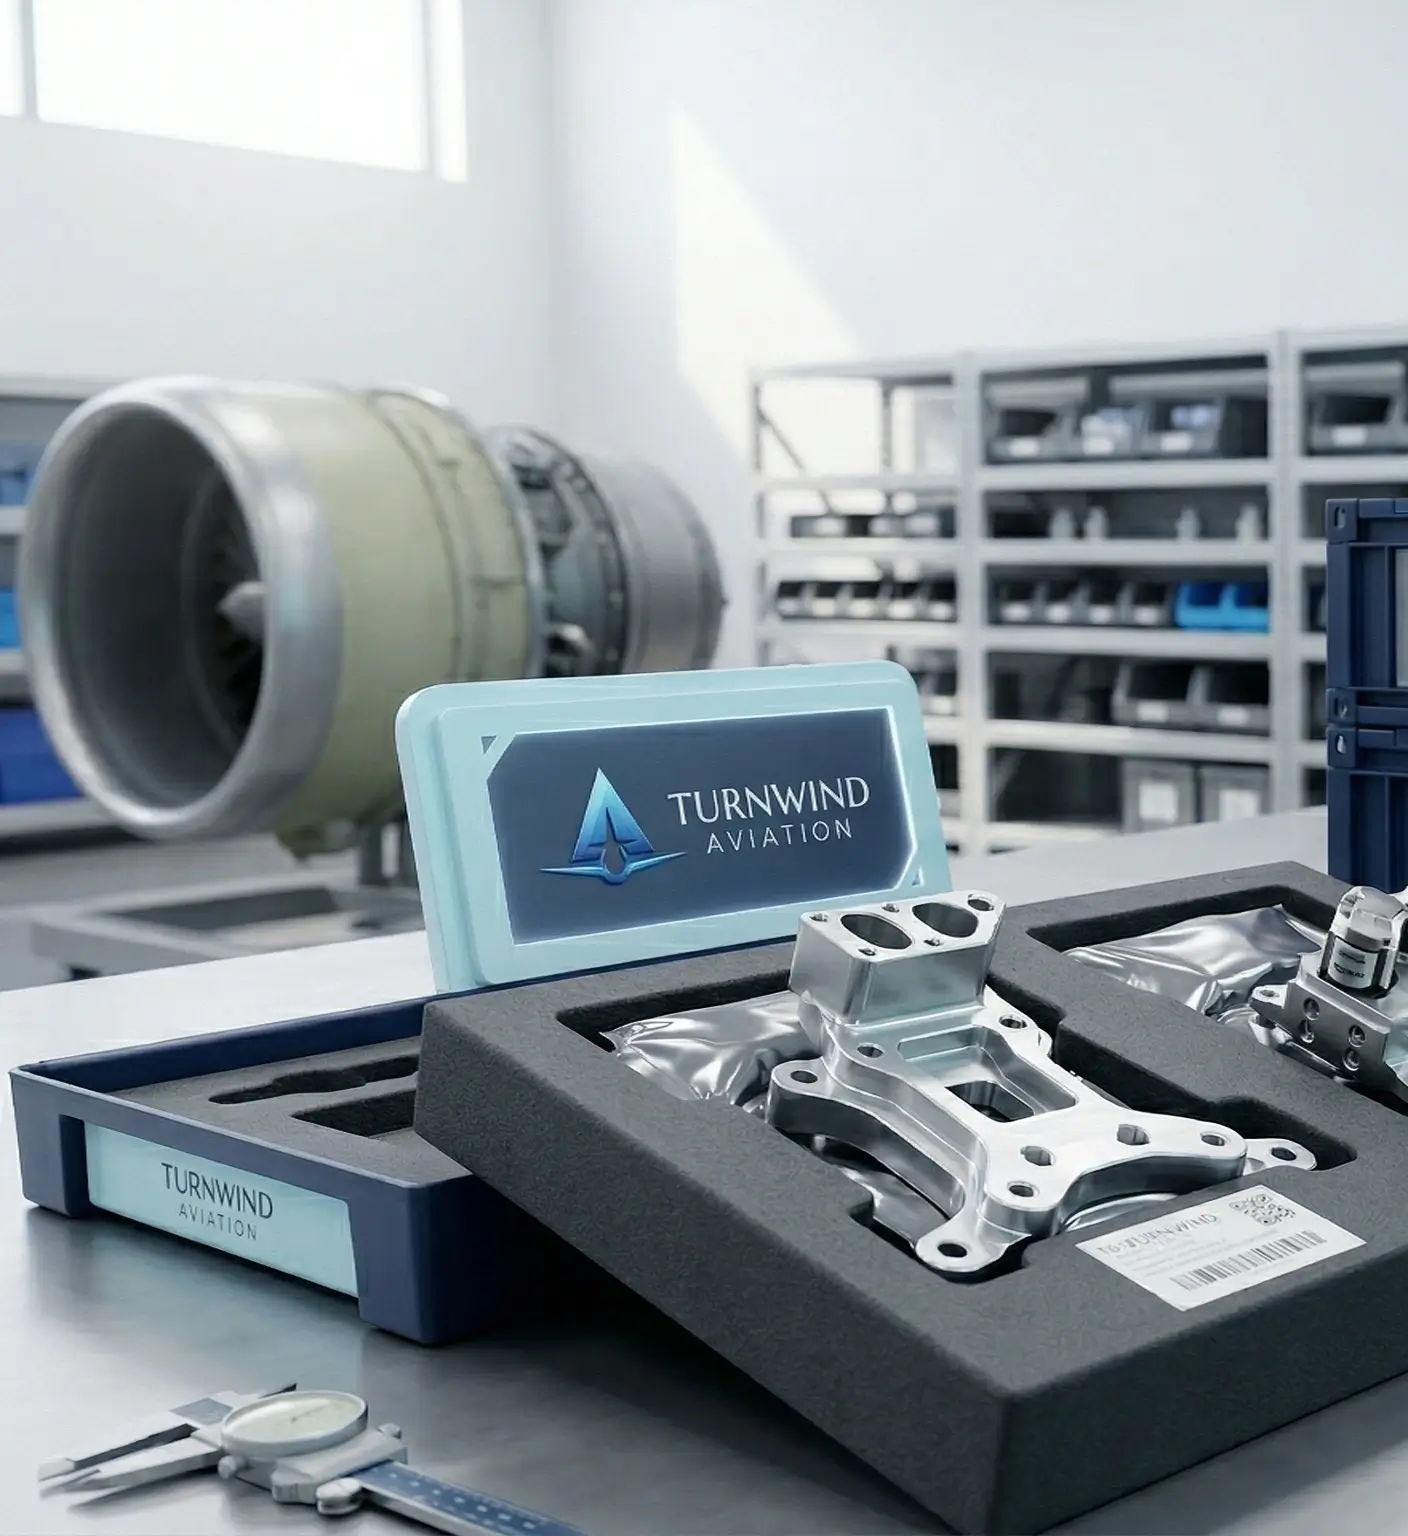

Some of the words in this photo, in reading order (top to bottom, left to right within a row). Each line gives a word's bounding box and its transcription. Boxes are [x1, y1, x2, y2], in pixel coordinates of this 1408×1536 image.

[667, 777, 870, 826] TURNWIND
[706, 818, 852, 854] AVIATION
[161, 1162, 273, 1219] TURNWIND
[179, 1203, 257, 1240] AVIATION
